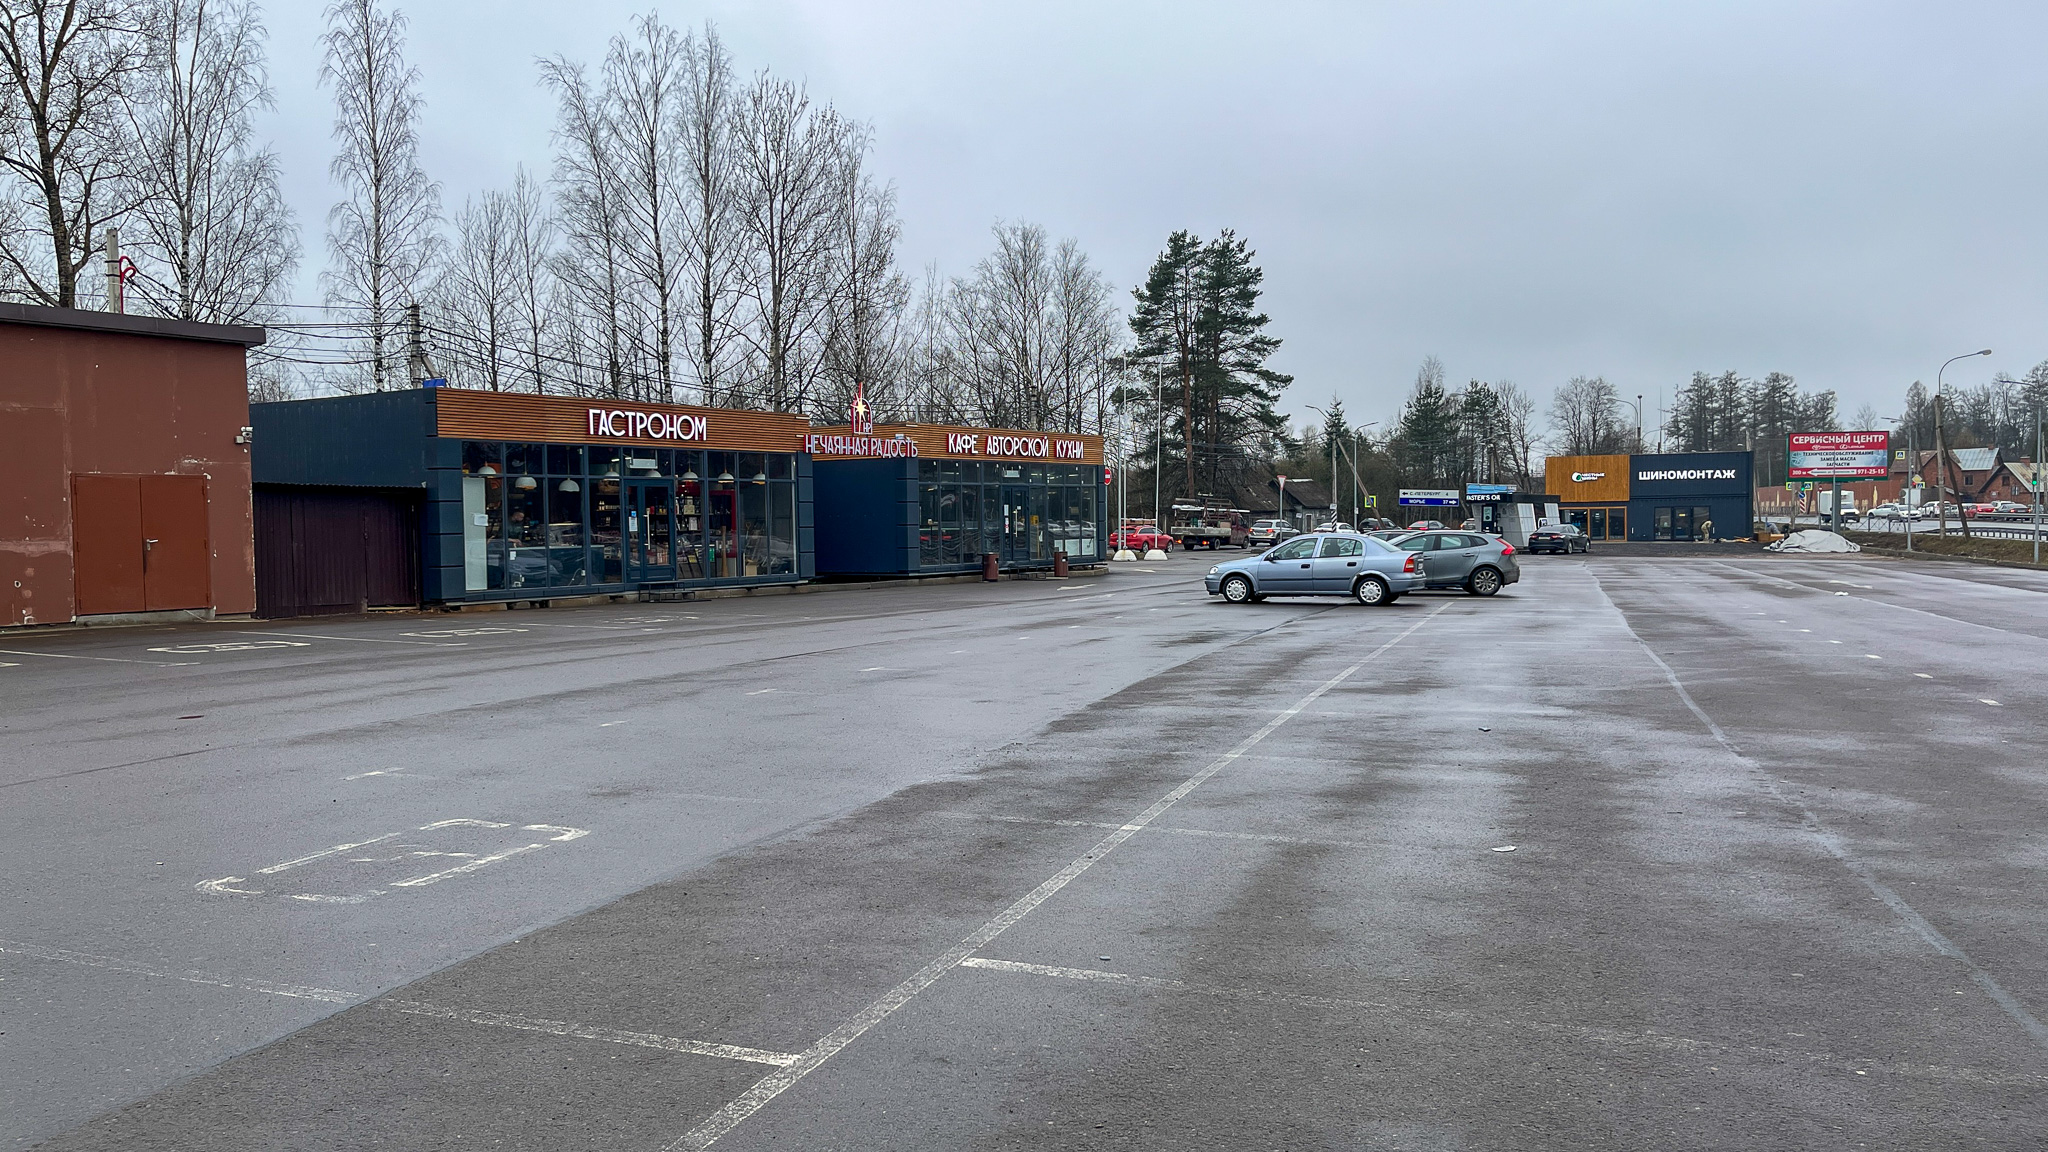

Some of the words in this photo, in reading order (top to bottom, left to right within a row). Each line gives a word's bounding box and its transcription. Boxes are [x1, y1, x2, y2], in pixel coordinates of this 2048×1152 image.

[588, 408, 707, 441] ГАСТРОНОМ
[804, 434, 868, 456] НЕЧАЯННАЯ
[871, 437, 919, 458] РАДОСТЬ
[948, 433, 979, 454] КАФЕ
[986, 435, 1049, 457] АВТОРСКОЙ
[1056, 440, 1084, 459] КУХНИ
[1792, 433, 1851, 444] СЕРВИСНЫЙ
[1853, 434, 1885, 444] ЦЕНТР
[1638, 469, 1736, 481] ШИНОМОНТАЖ
